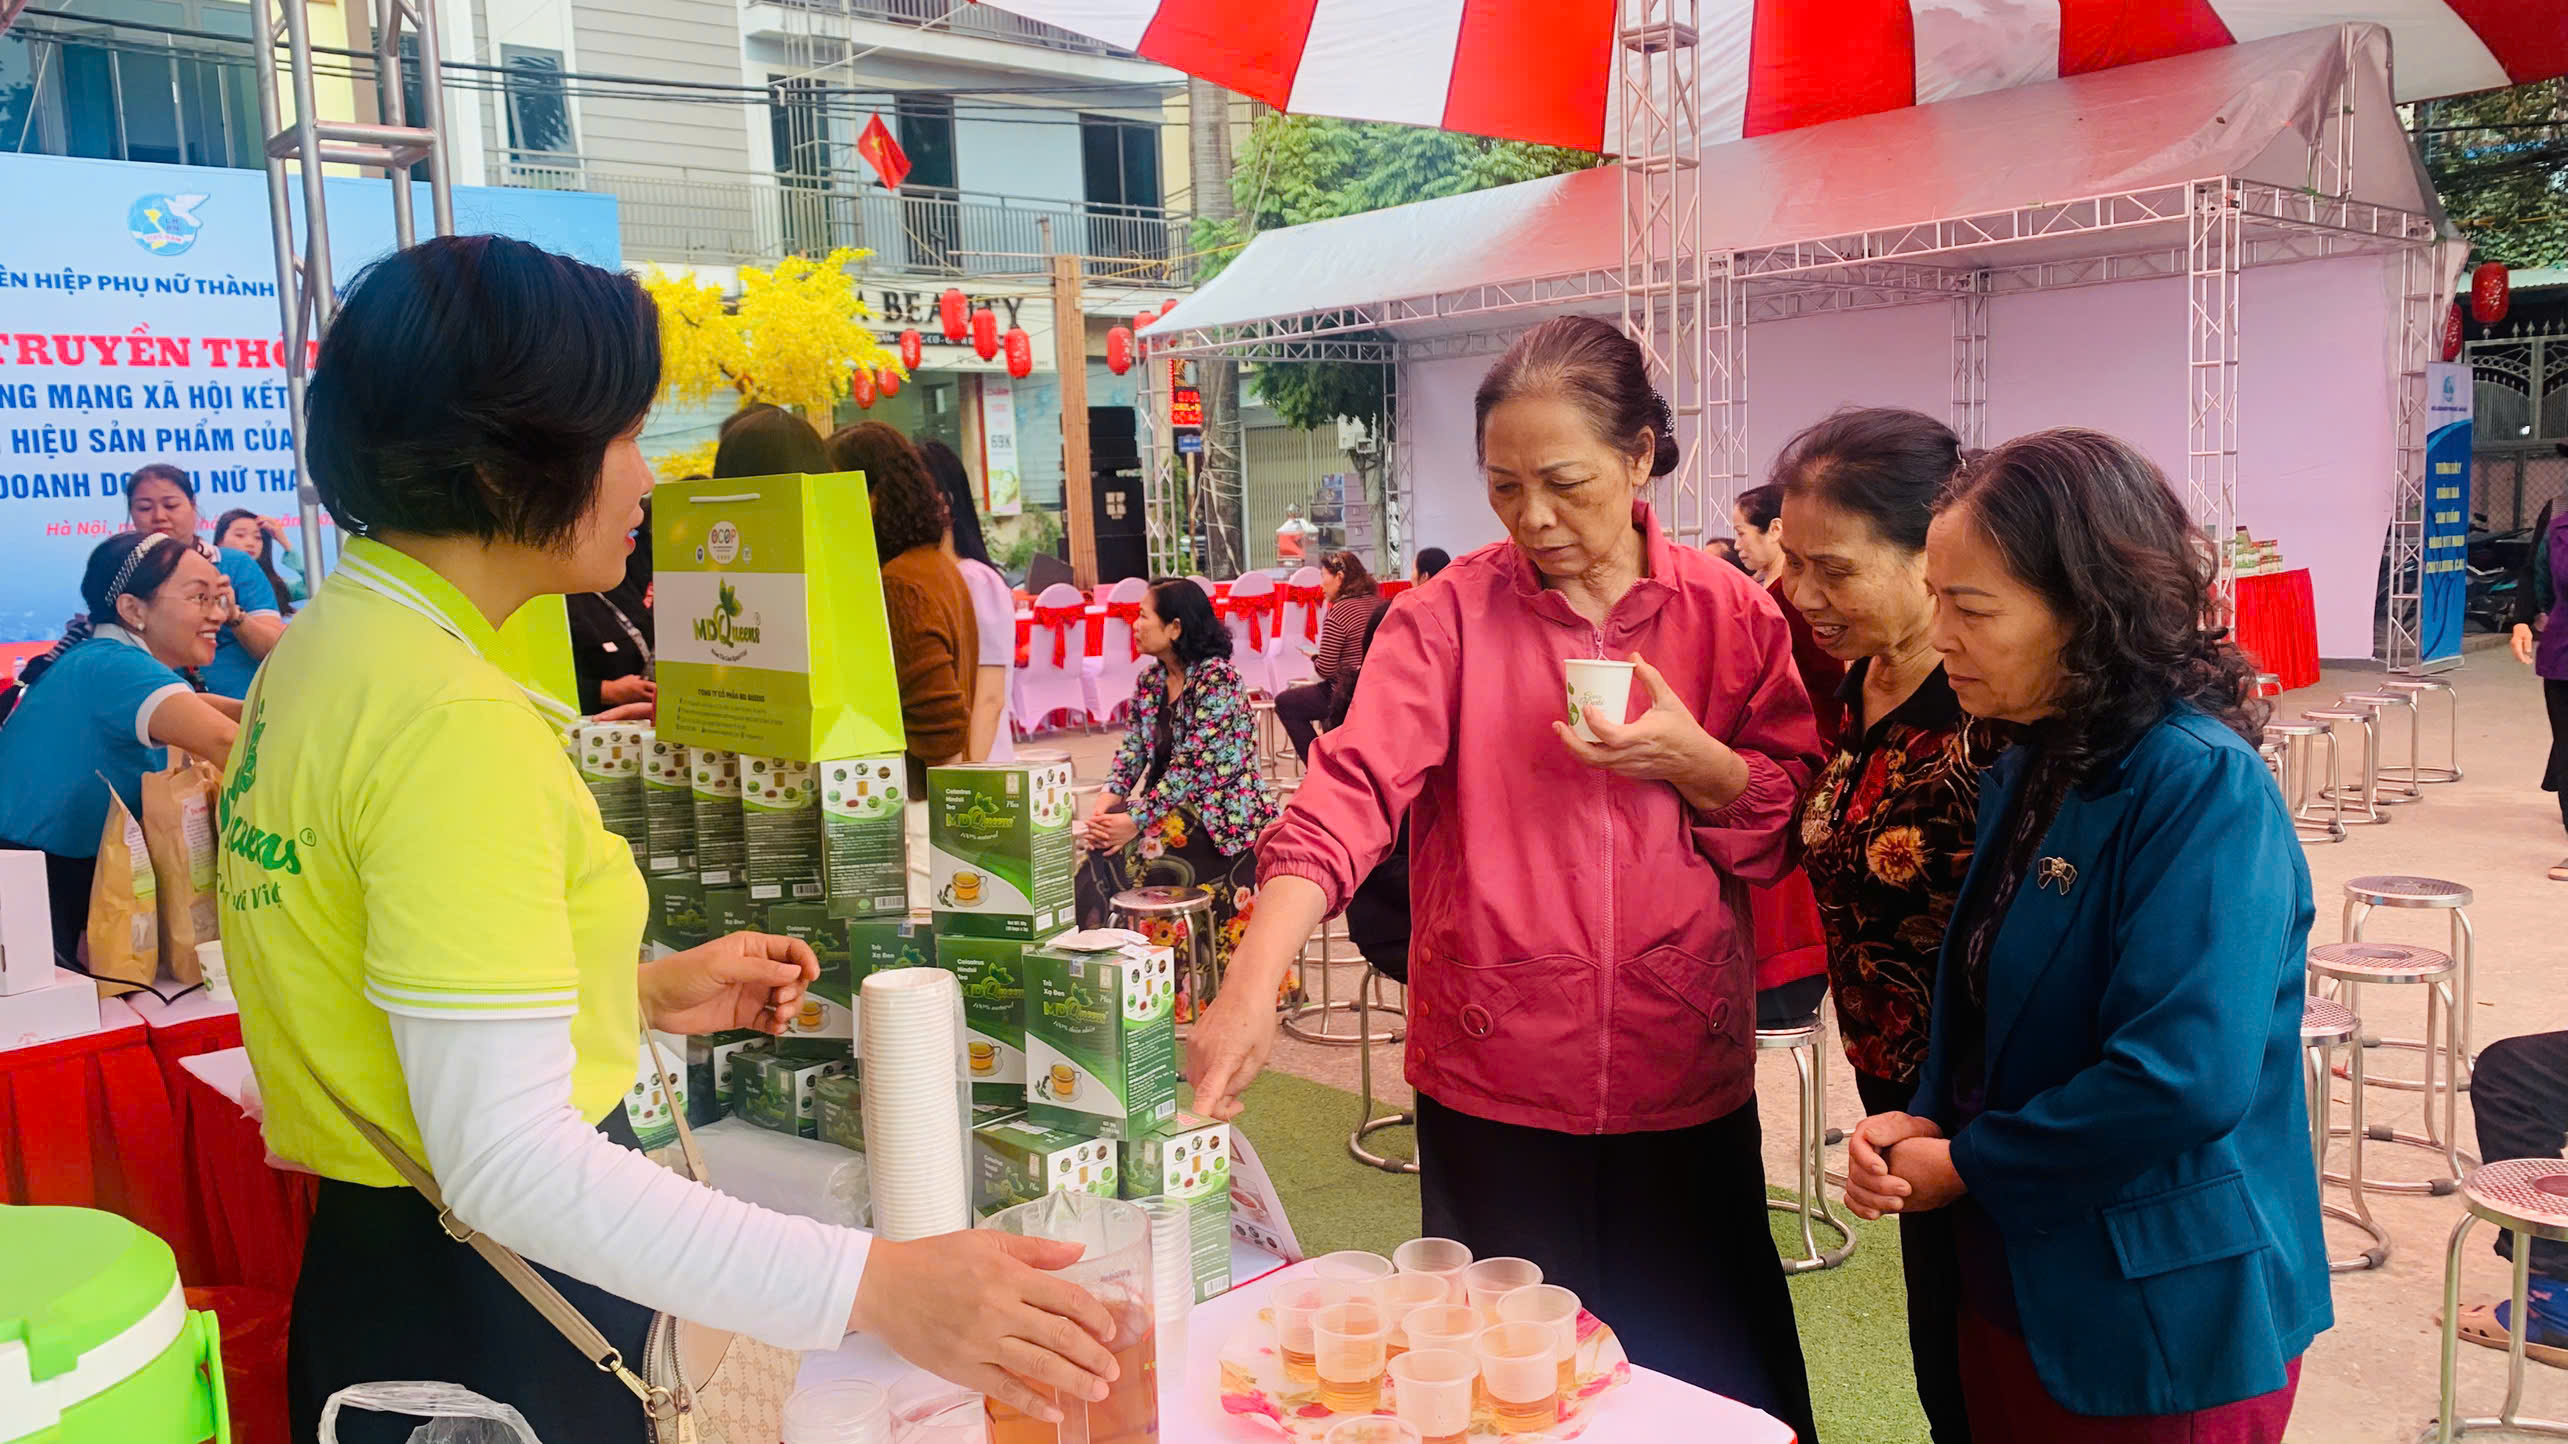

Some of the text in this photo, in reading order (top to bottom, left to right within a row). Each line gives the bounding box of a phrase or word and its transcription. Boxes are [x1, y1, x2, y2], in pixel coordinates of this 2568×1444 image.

[34, 267, 92, 295] HIỆP
[98, 275, 148, 298] PHỤ
[155, 273, 191, 294] NỮ
[195, 273, 275, 297] THÀNH
[0, 322, 191, 368] RUYỀN
[48, 384, 133, 414] MẠNG
[145, 380, 180, 409] XÃ
[189, 380, 232, 414] HỘI
[243, 378, 288, 409] KẾT
[12, 418, 293, 459] HIỆU SẢN PHẨM CỦA
[212, 465, 248, 493] NỮ
[46, 519, 70, 537] Hà
[77, 519, 112, 539] Nội,
[1042, 979, 1052, 987] Trà
